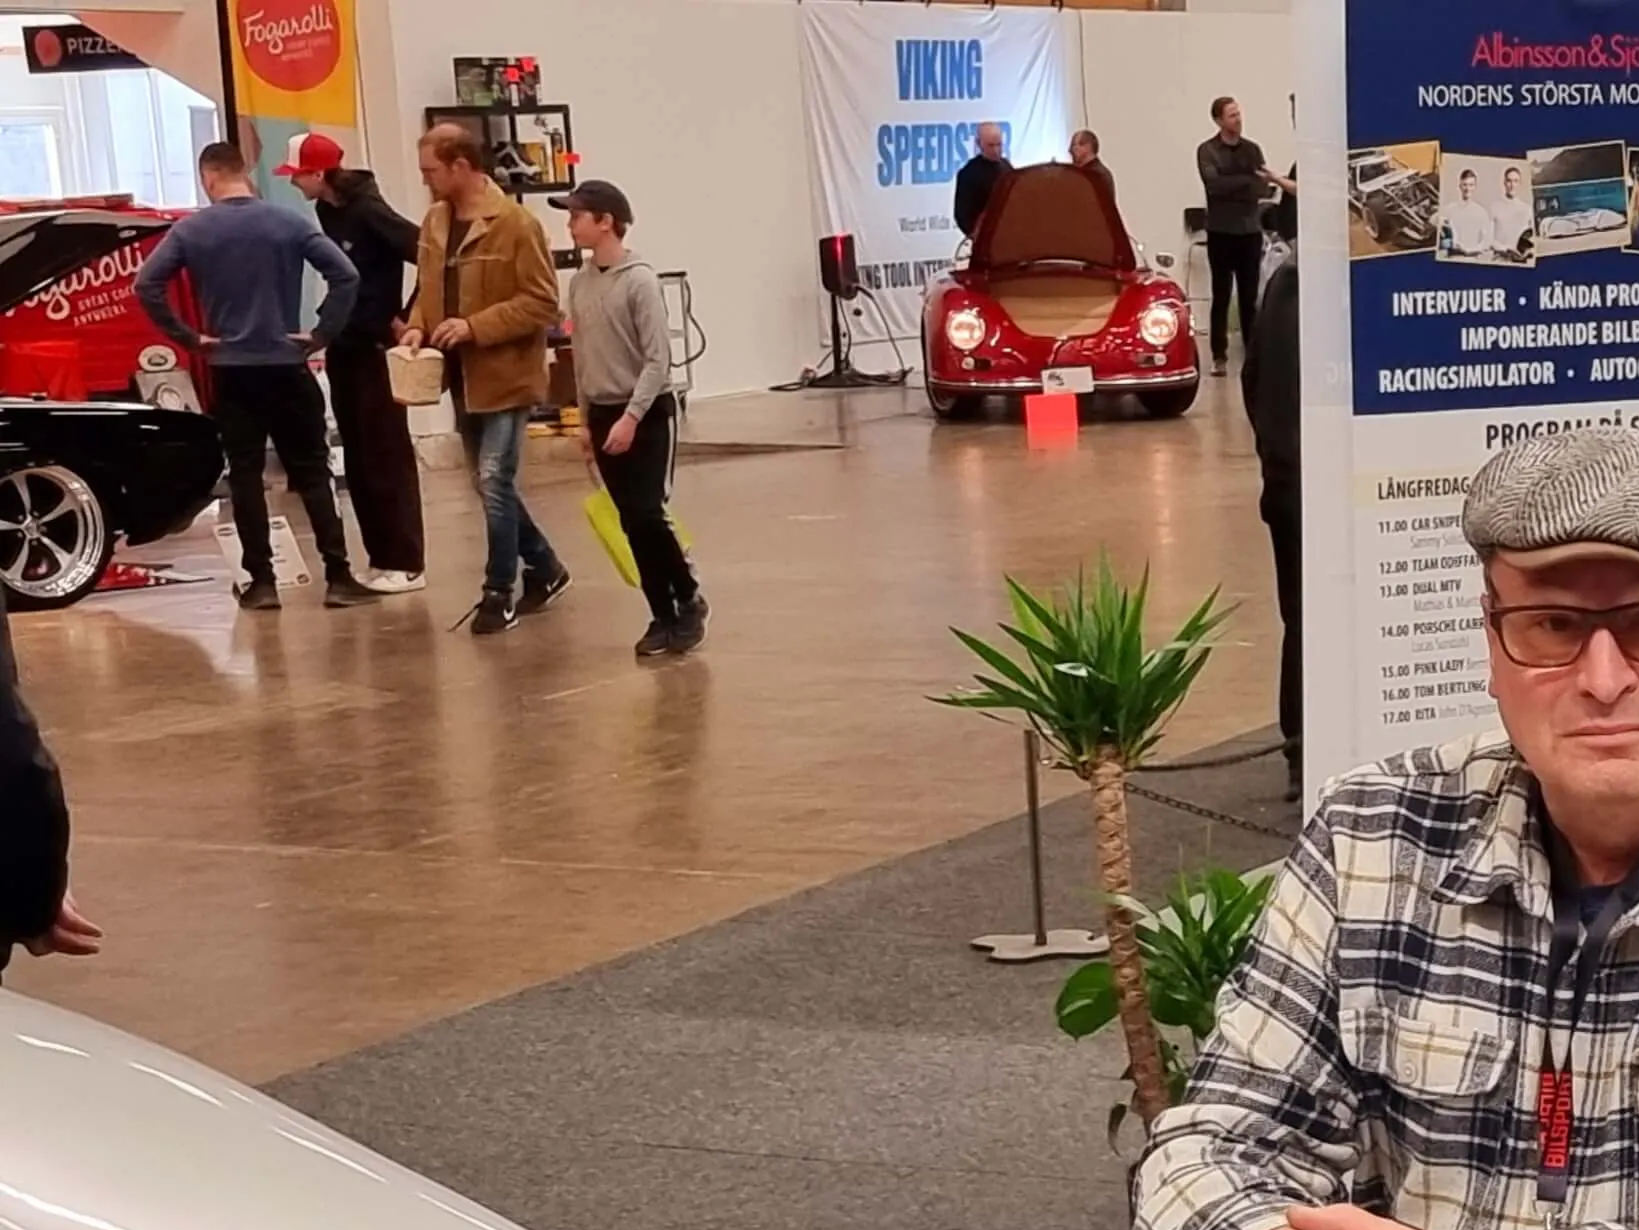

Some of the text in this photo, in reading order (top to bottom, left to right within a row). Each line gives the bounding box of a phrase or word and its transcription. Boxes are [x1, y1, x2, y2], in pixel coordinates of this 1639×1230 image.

[243, 3, 333, 54] Fogarolli
[66, 37, 120, 54] PIZZE
[895, 39, 983, 101] VIKING
[1418, 83, 1514, 107] NORDENS
[1520, 80, 1604, 106] STÖRSTA
[1393, 288, 1506, 316] INTERVJUER
[1539, 280, 1602, 310] KÄNDA
[1461, 322, 1598, 351] IMPONERANDE
[1379, 361, 1556, 393] RACINGSIMULATOR
[1378, 476, 1469, 500] LÅNGFREDAG
[1379, 520, 1408, 533] 11.00
[1380, 560, 1408, 574] 12.00
[1381, 624, 1409, 638] 14.00
[1382, 665, 1410, 678] 15.00
[1382, 688, 1410, 702] 16.00
[1383, 711, 1411, 724] 17.00
[1545, 1074, 1572, 1169] BILSPORT
